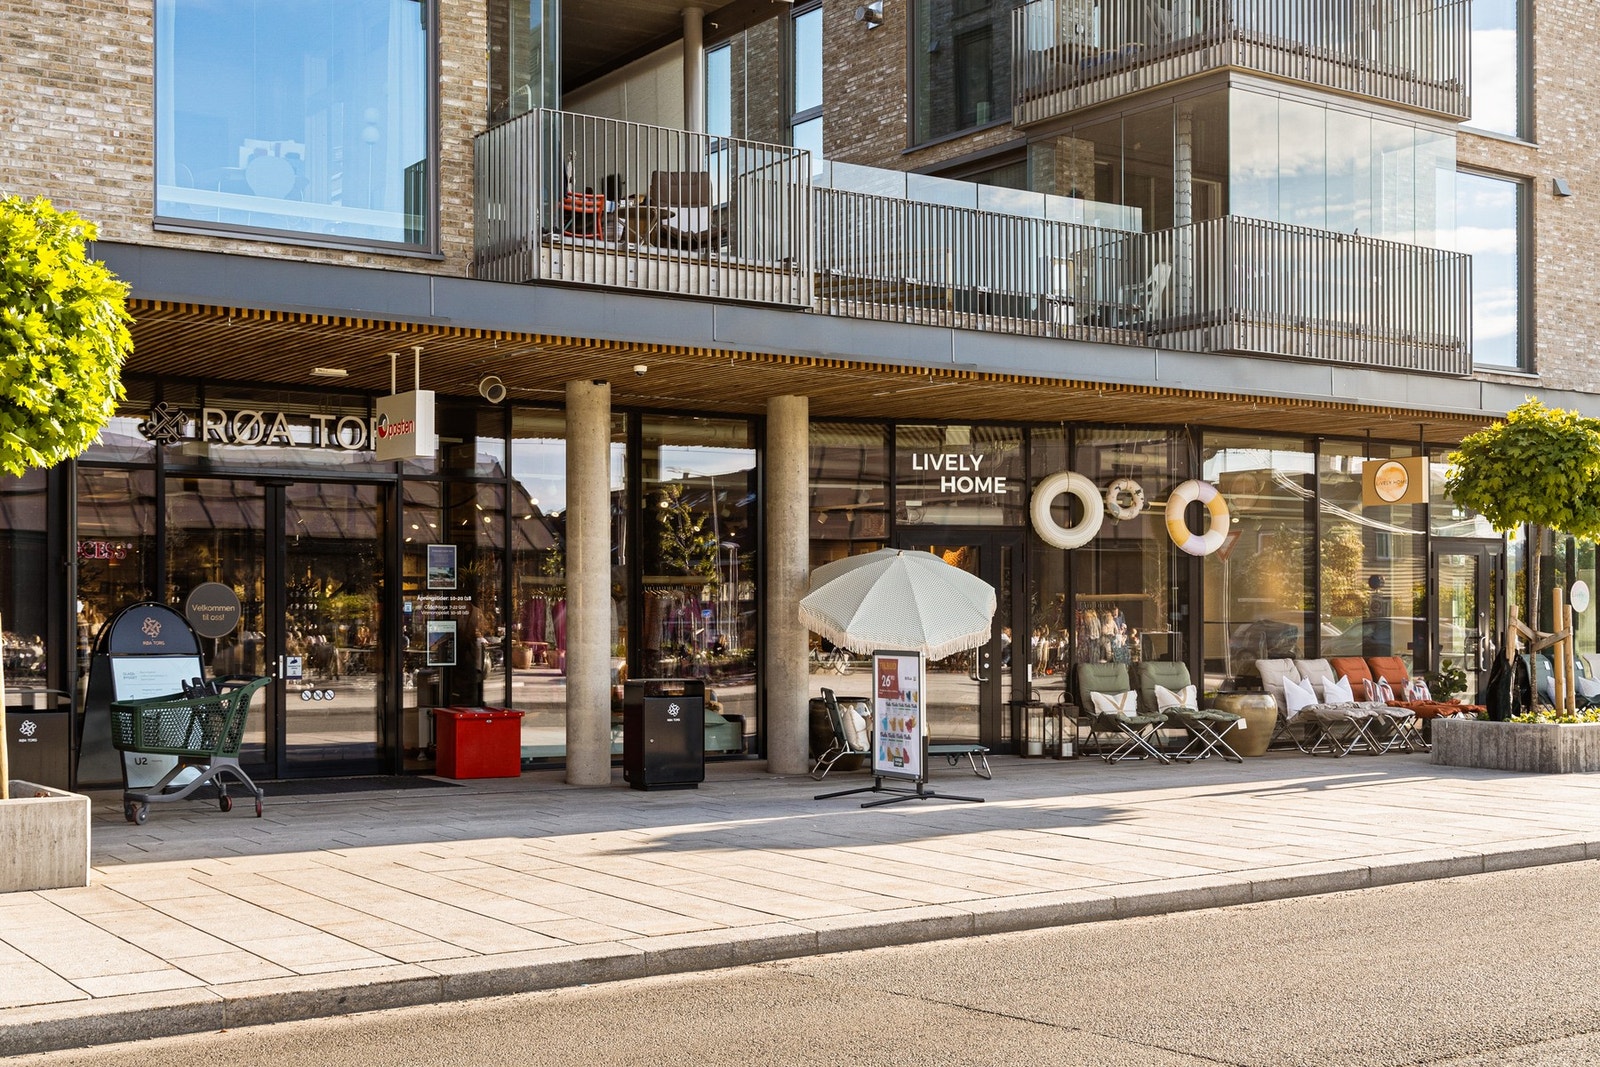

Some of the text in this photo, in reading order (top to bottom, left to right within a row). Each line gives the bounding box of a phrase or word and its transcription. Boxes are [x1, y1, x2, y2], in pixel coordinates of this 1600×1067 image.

[203, 408, 297, 451] RØA
[388, 419, 415, 440] posten
[912, 453, 984, 471] LIVELY
[941, 476, 1007, 494] HOME
[77, 541, 127, 559] CESS
[192, 604, 236, 612] Velkommen
[881, 675, 891, 687] 26
[135, 757, 148, 766] U2
